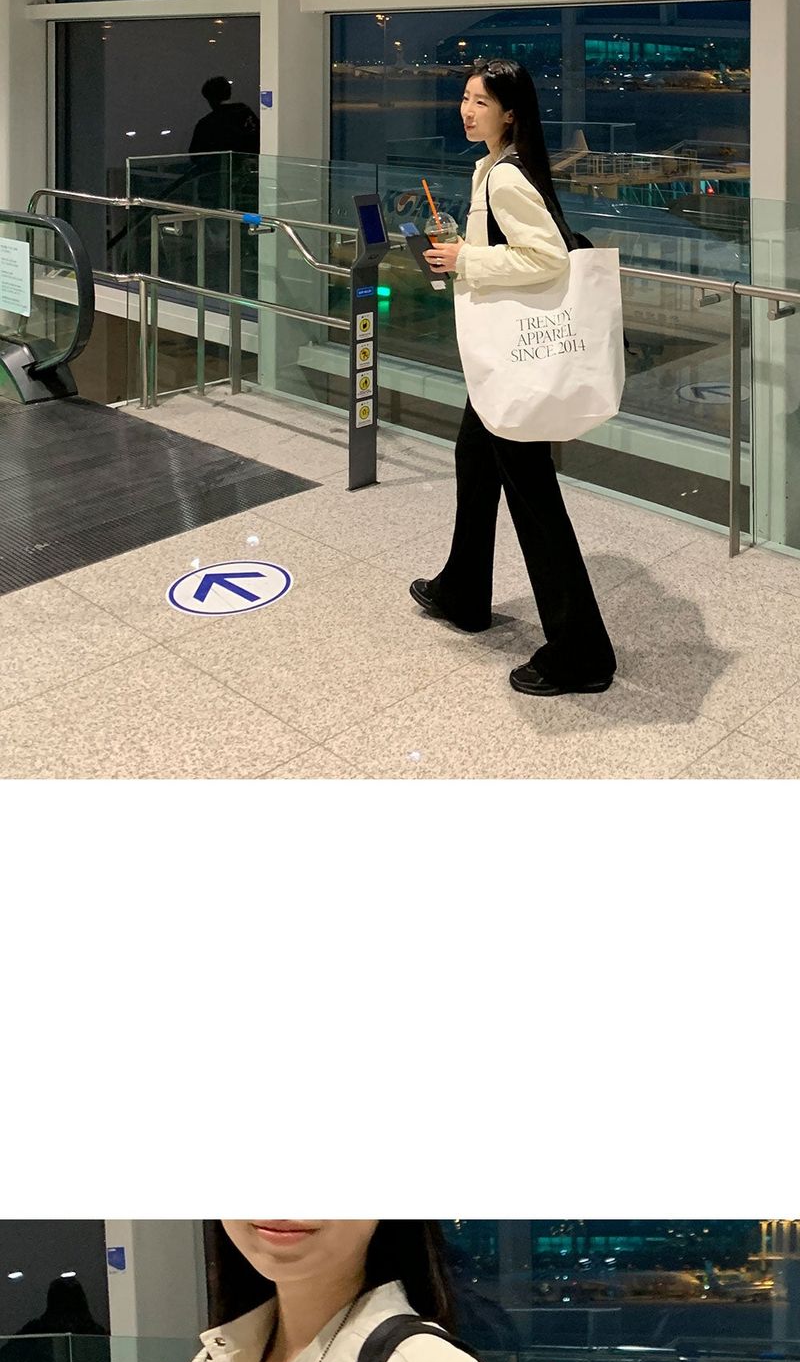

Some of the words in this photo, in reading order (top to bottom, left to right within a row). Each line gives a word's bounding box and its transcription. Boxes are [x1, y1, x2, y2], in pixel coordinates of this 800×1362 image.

[516, 308, 572, 331] TRENDY
[517, 324, 576, 346] APPAREL
[558, 339, 585, 354] 2014
